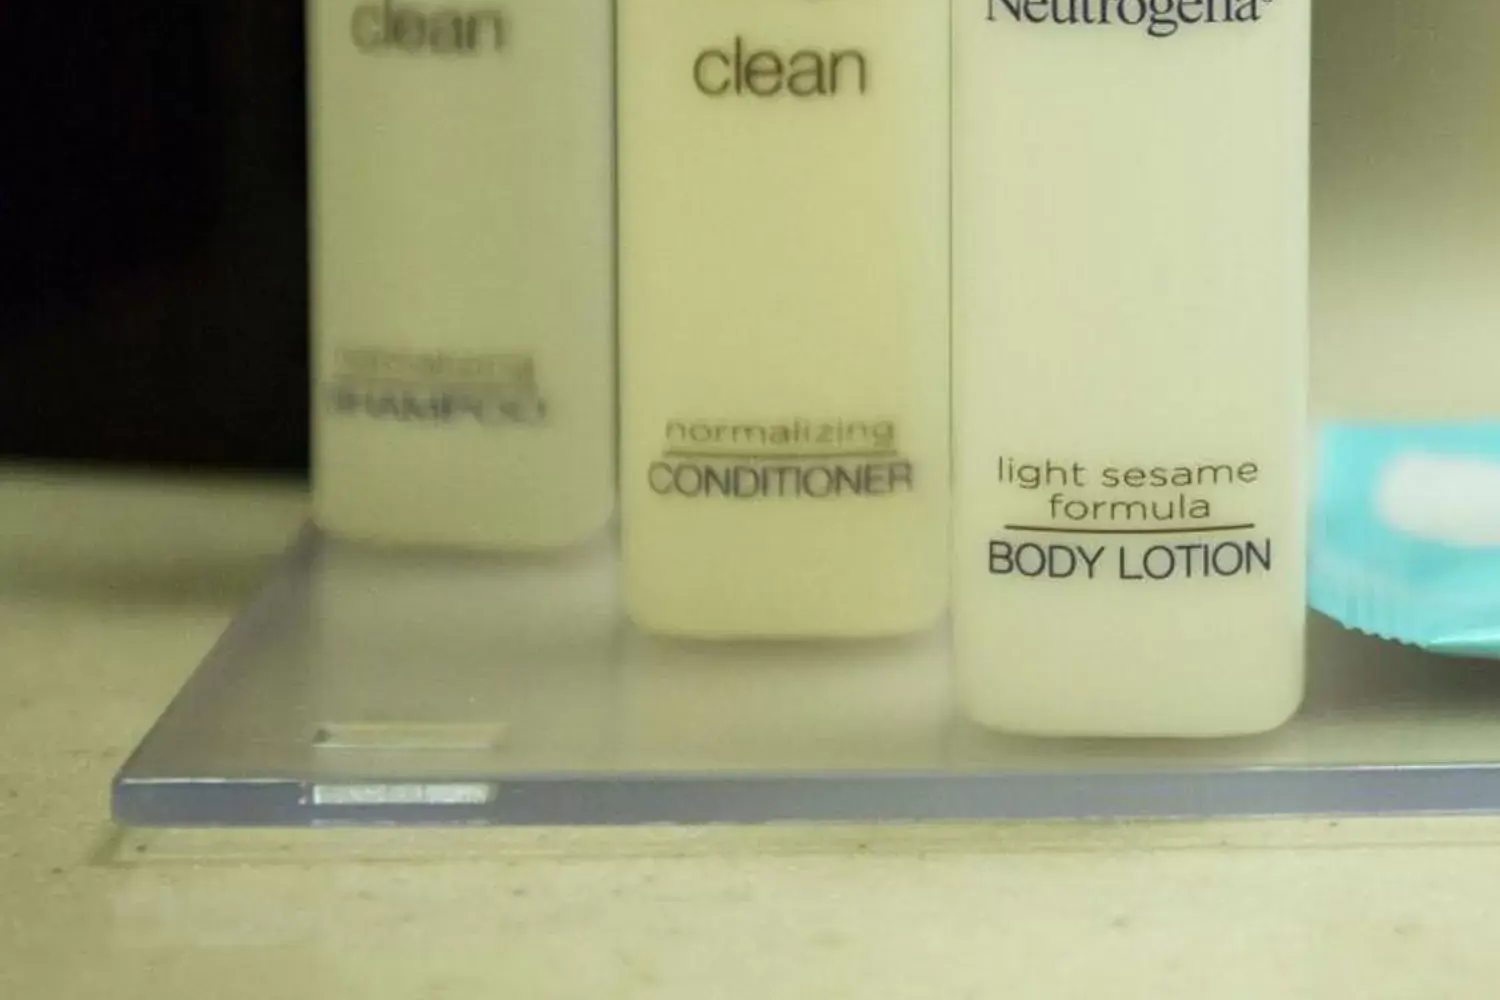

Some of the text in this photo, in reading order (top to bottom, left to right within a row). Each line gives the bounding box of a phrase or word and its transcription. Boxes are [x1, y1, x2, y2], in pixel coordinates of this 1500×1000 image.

[692, 35, 868, 98] clean
[664, 416, 896, 447] normalizing
[648, 459, 915, 499] CONDITIONER
[998, 455, 1259, 490] light sesame
[1049, 493, 1212, 521] formula
[988, 539, 1272, 580] BODY LOTION
